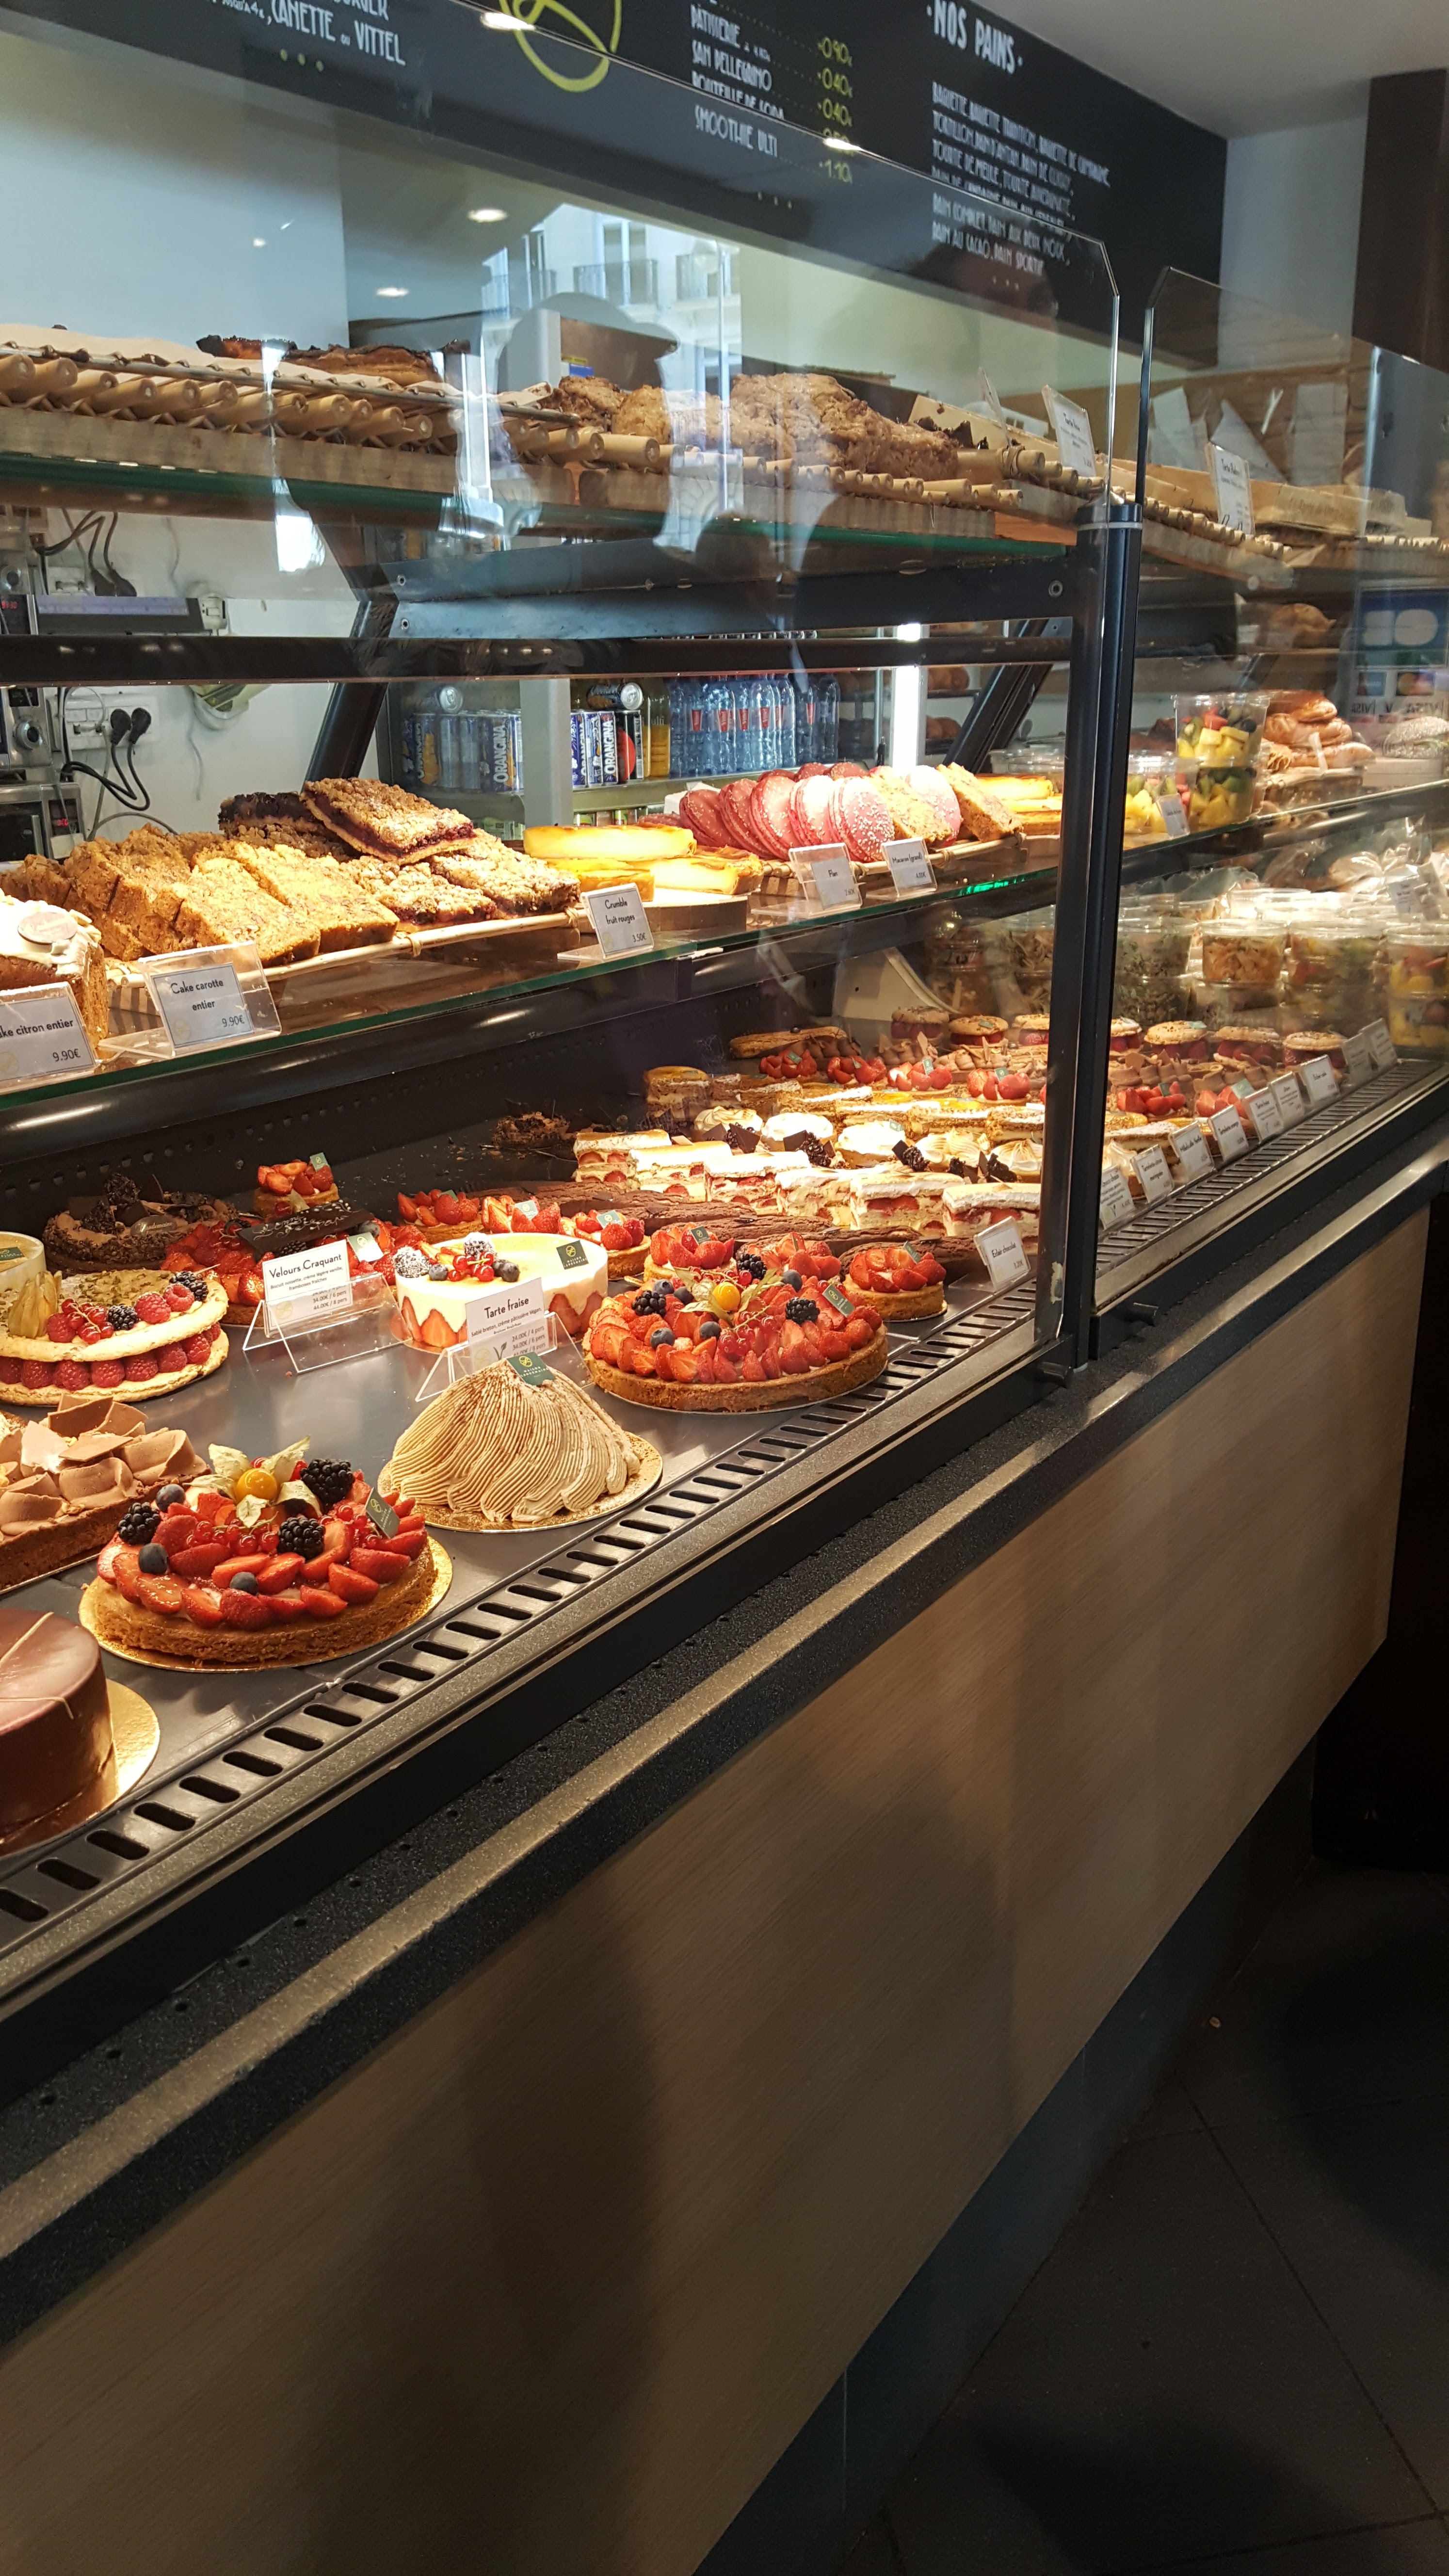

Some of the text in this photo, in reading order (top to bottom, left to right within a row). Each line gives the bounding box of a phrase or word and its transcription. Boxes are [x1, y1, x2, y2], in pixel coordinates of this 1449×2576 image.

[272, 0, 336, 42] CANETTE
[354, 20, 406, 66] VITTEL
[934, 0, 1015, 74] NOS PAINS
[692, 40, 711, 67] SAN
[694, 104, 754, 150] SMOOTHIE
[493, 724, 509, 784] ORANGINA
[603, 720, 616, 774] ORANGINA
[605, 897, 628, 909] Crumble
[618, 915, 635, 924] rouges
[632, 933, 646, 942] 3.50€
[171, 980, 224, 994] Cake carotte
[192, 1000, 215, 1011] entier
[16, 1025, 44, 1035] citron
[47, 1019, 74, 1030] entier
[222, 1015, 244, 1027] 9.90€
[52, 1048, 80, 1062] 9.90€
[269, 1254, 342, 1278] Velours Craquant
[289, 1282, 311, 1290] framboises
[484, 1298, 529, 1319] Tarte fraise
[483, 1324, 497, 1332] breton,
[511, 1312, 529, 1323] pâtissière
[512, 1331, 527, 1342] 24.00€
[535, 1326, 545, 1334] pers
[513, 1340, 528, 1351] 34.00€
[536, 1334, 545, 1342] pers
[520, 1367, 549, 1377] LANDEMAINE
